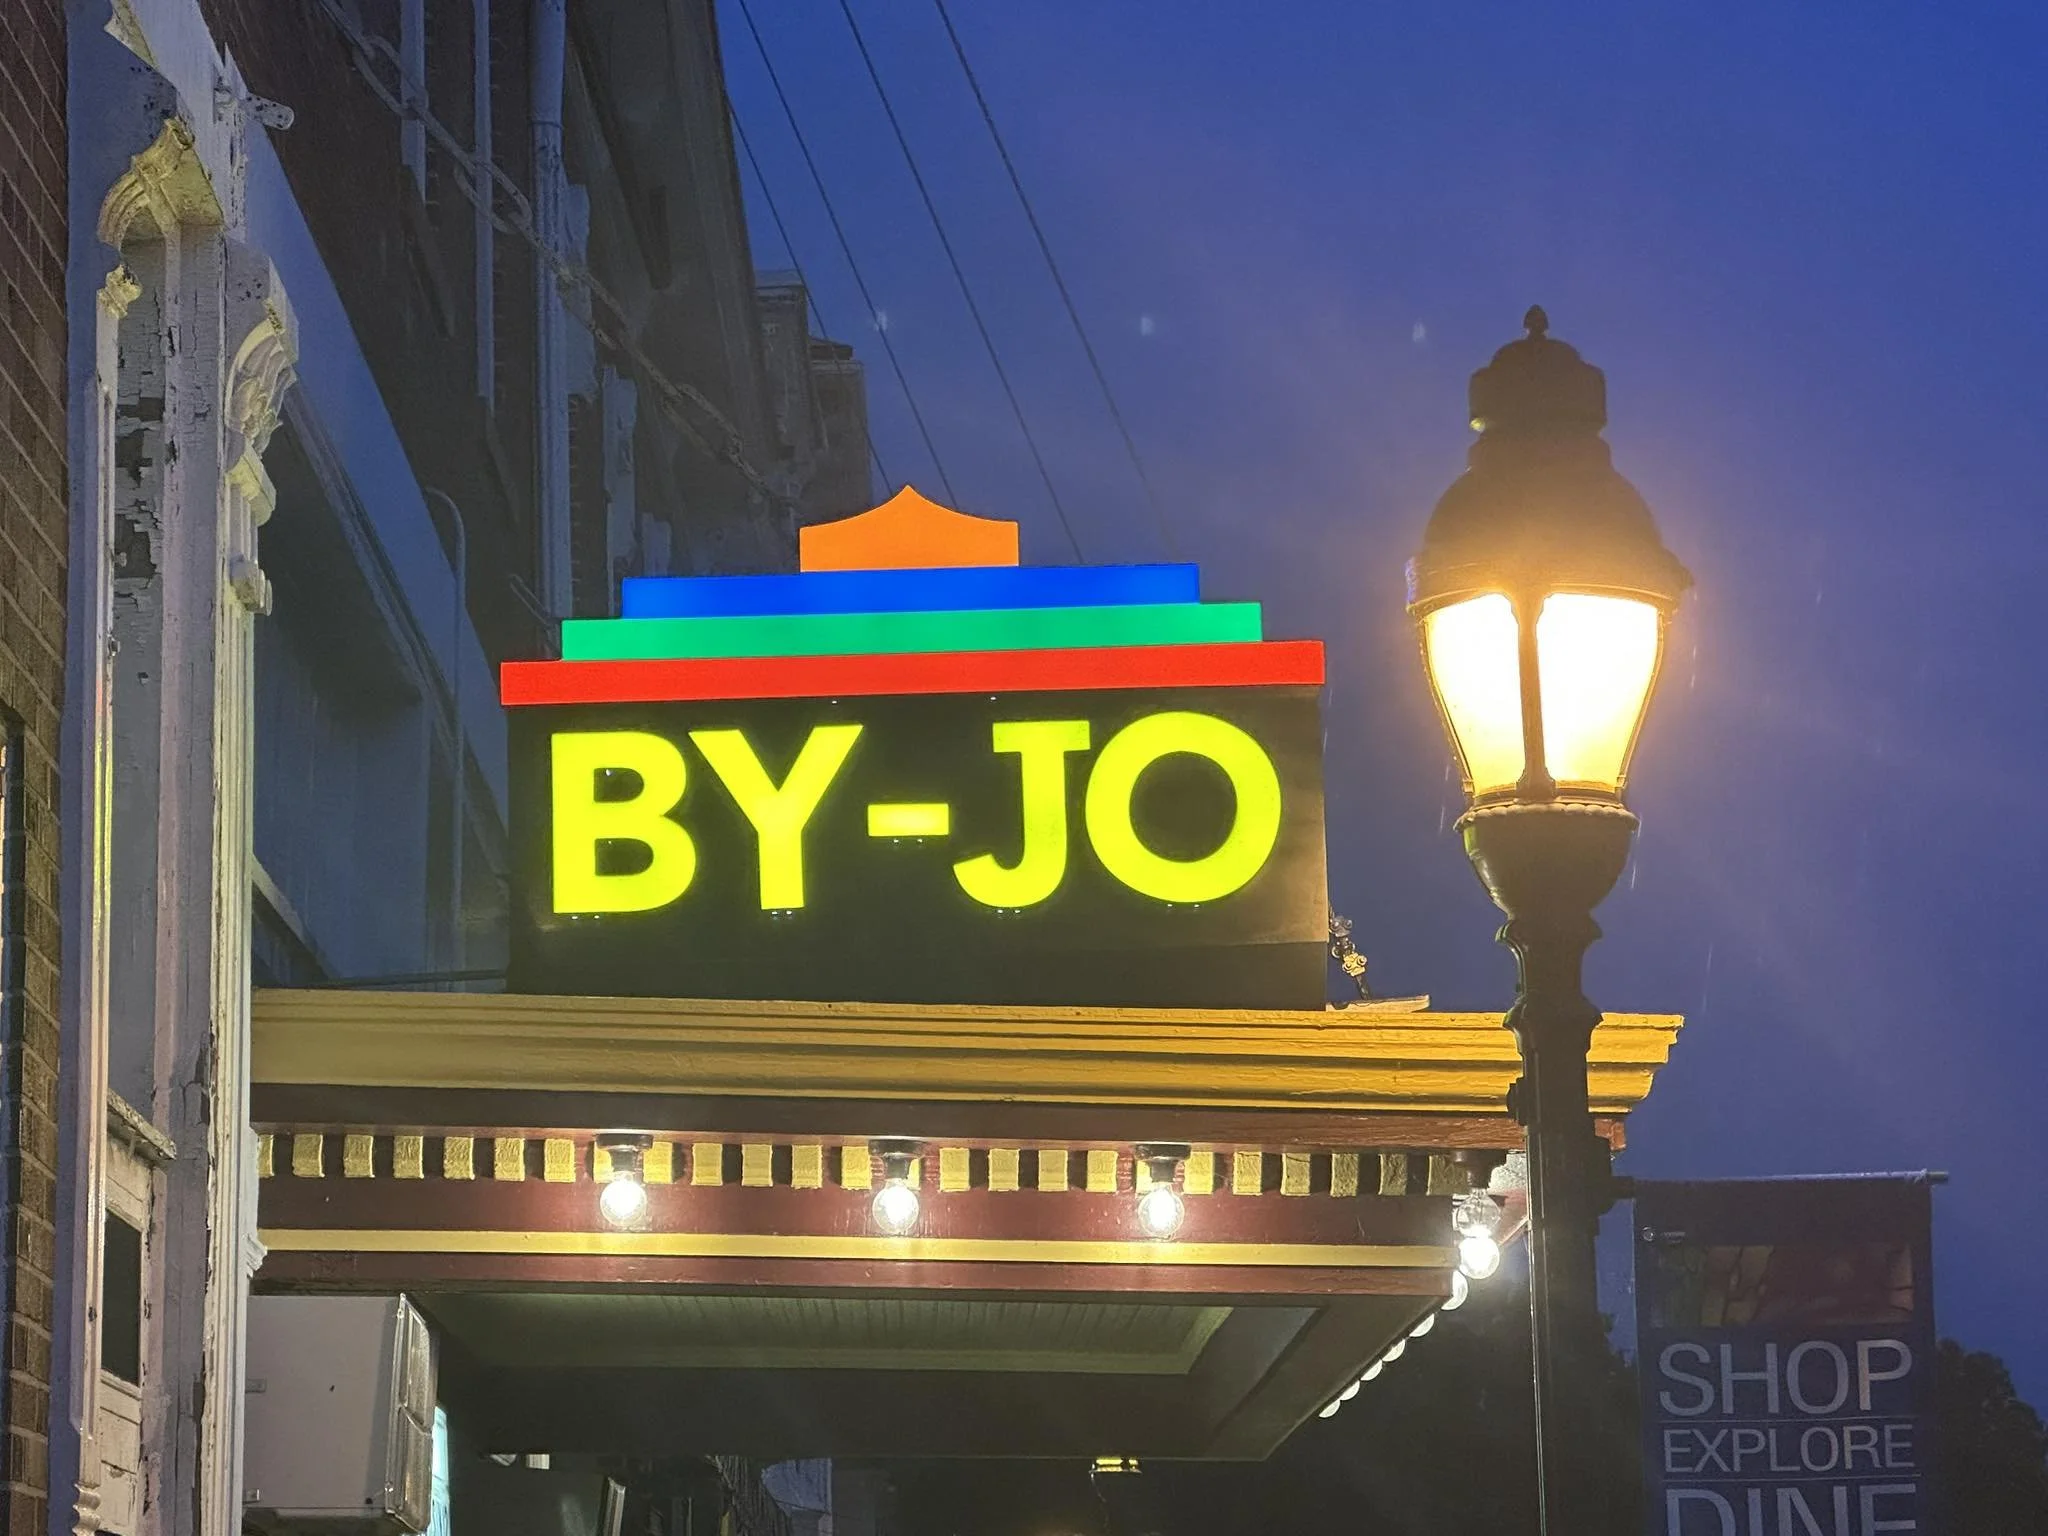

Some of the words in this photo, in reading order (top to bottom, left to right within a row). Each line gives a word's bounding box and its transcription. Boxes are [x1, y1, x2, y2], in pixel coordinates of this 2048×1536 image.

[550, 711, 1282, 914] BY-JO
[1659, 1339, 1913, 1416] SHOP
[1663, 1424, 1915, 1473] EXPLORE
[1666, 1483, 1916, 1536] DINE
